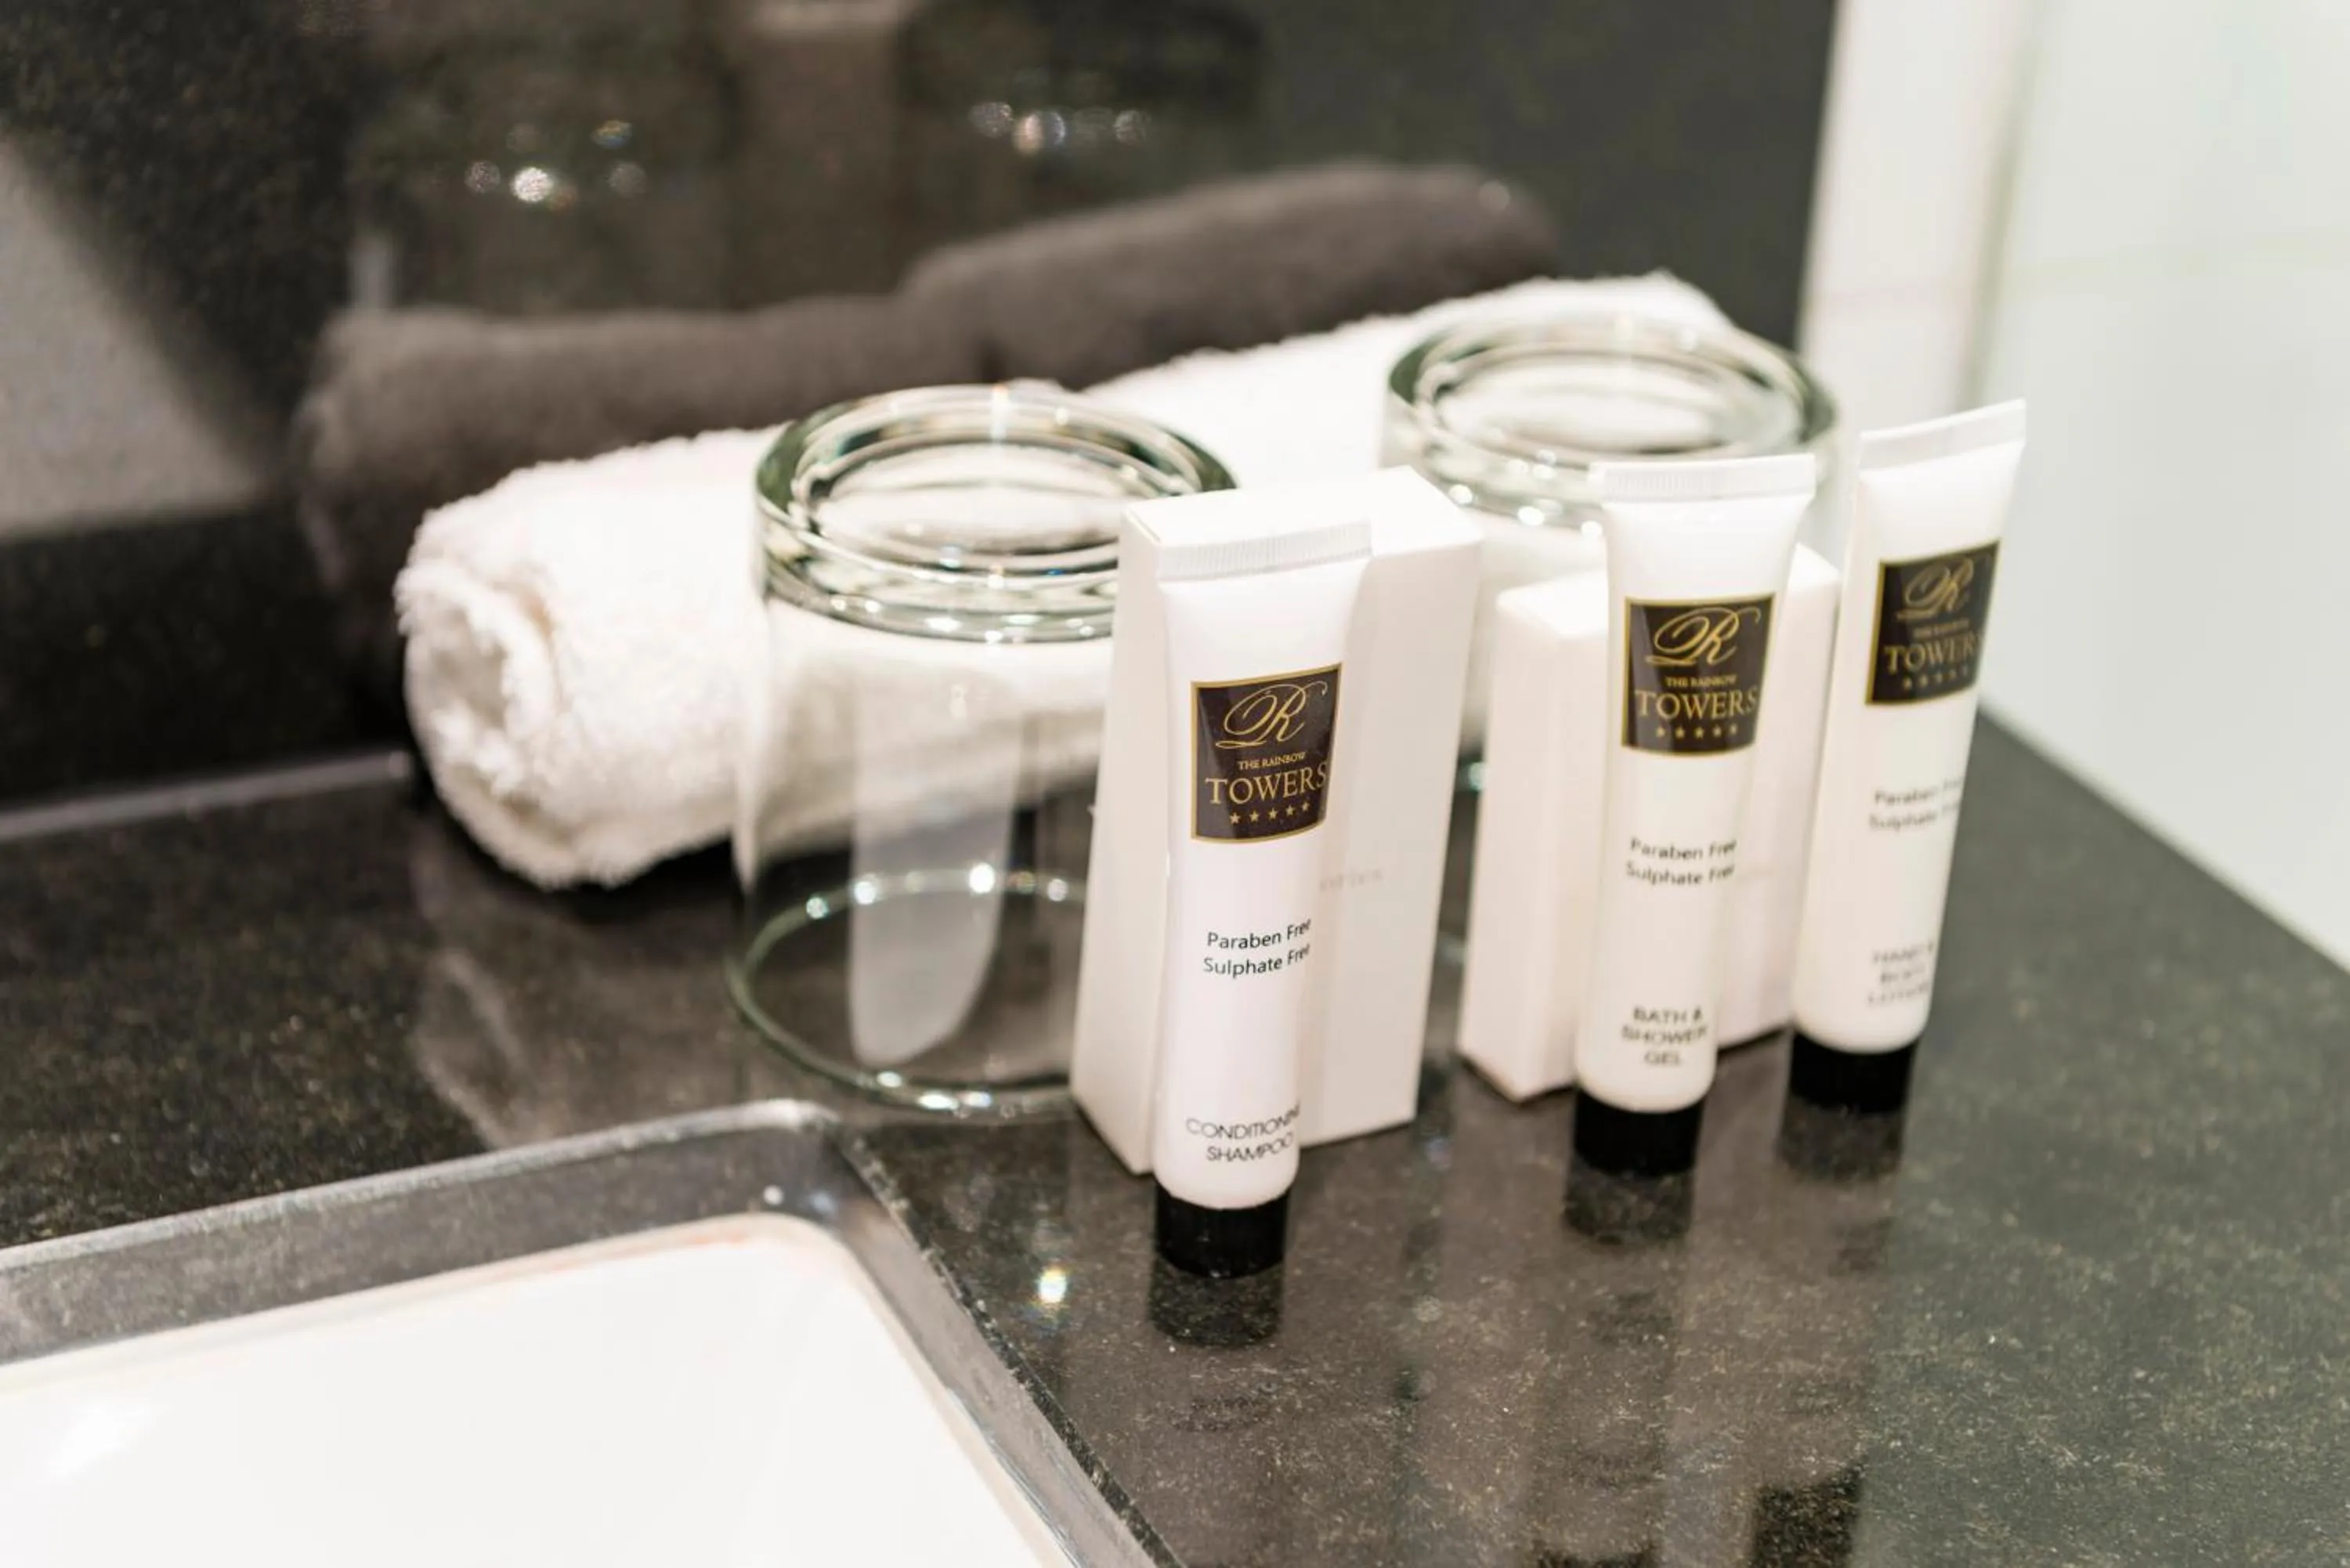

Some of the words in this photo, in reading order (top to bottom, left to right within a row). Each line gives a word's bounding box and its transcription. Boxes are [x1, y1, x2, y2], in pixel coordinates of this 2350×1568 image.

[1884, 630, 1979, 674] TOWER
[1665, 676, 1688, 688] THE
[1635, 685, 1759, 721] TOWERS
[1216, 681, 1329, 750] R
[1238, 759, 1260, 771] THE
[1262, 751, 1307, 768] RAINBOW
[1205, 761, 1327, 805] TOWERS
[1630, 836, 1704, 860] Paraben
[1625, 860, 1704, 886] Sulphate
[1206, 931, 1282, 950] Paraben
[1203, 956, 1283, 979] Sulphate
[1633, 1007, 1687, 1024] BATH
[1643, 1050, 1682, 1067] GEL
[1206, 1132, 1294, 1163] SHAMPOO
